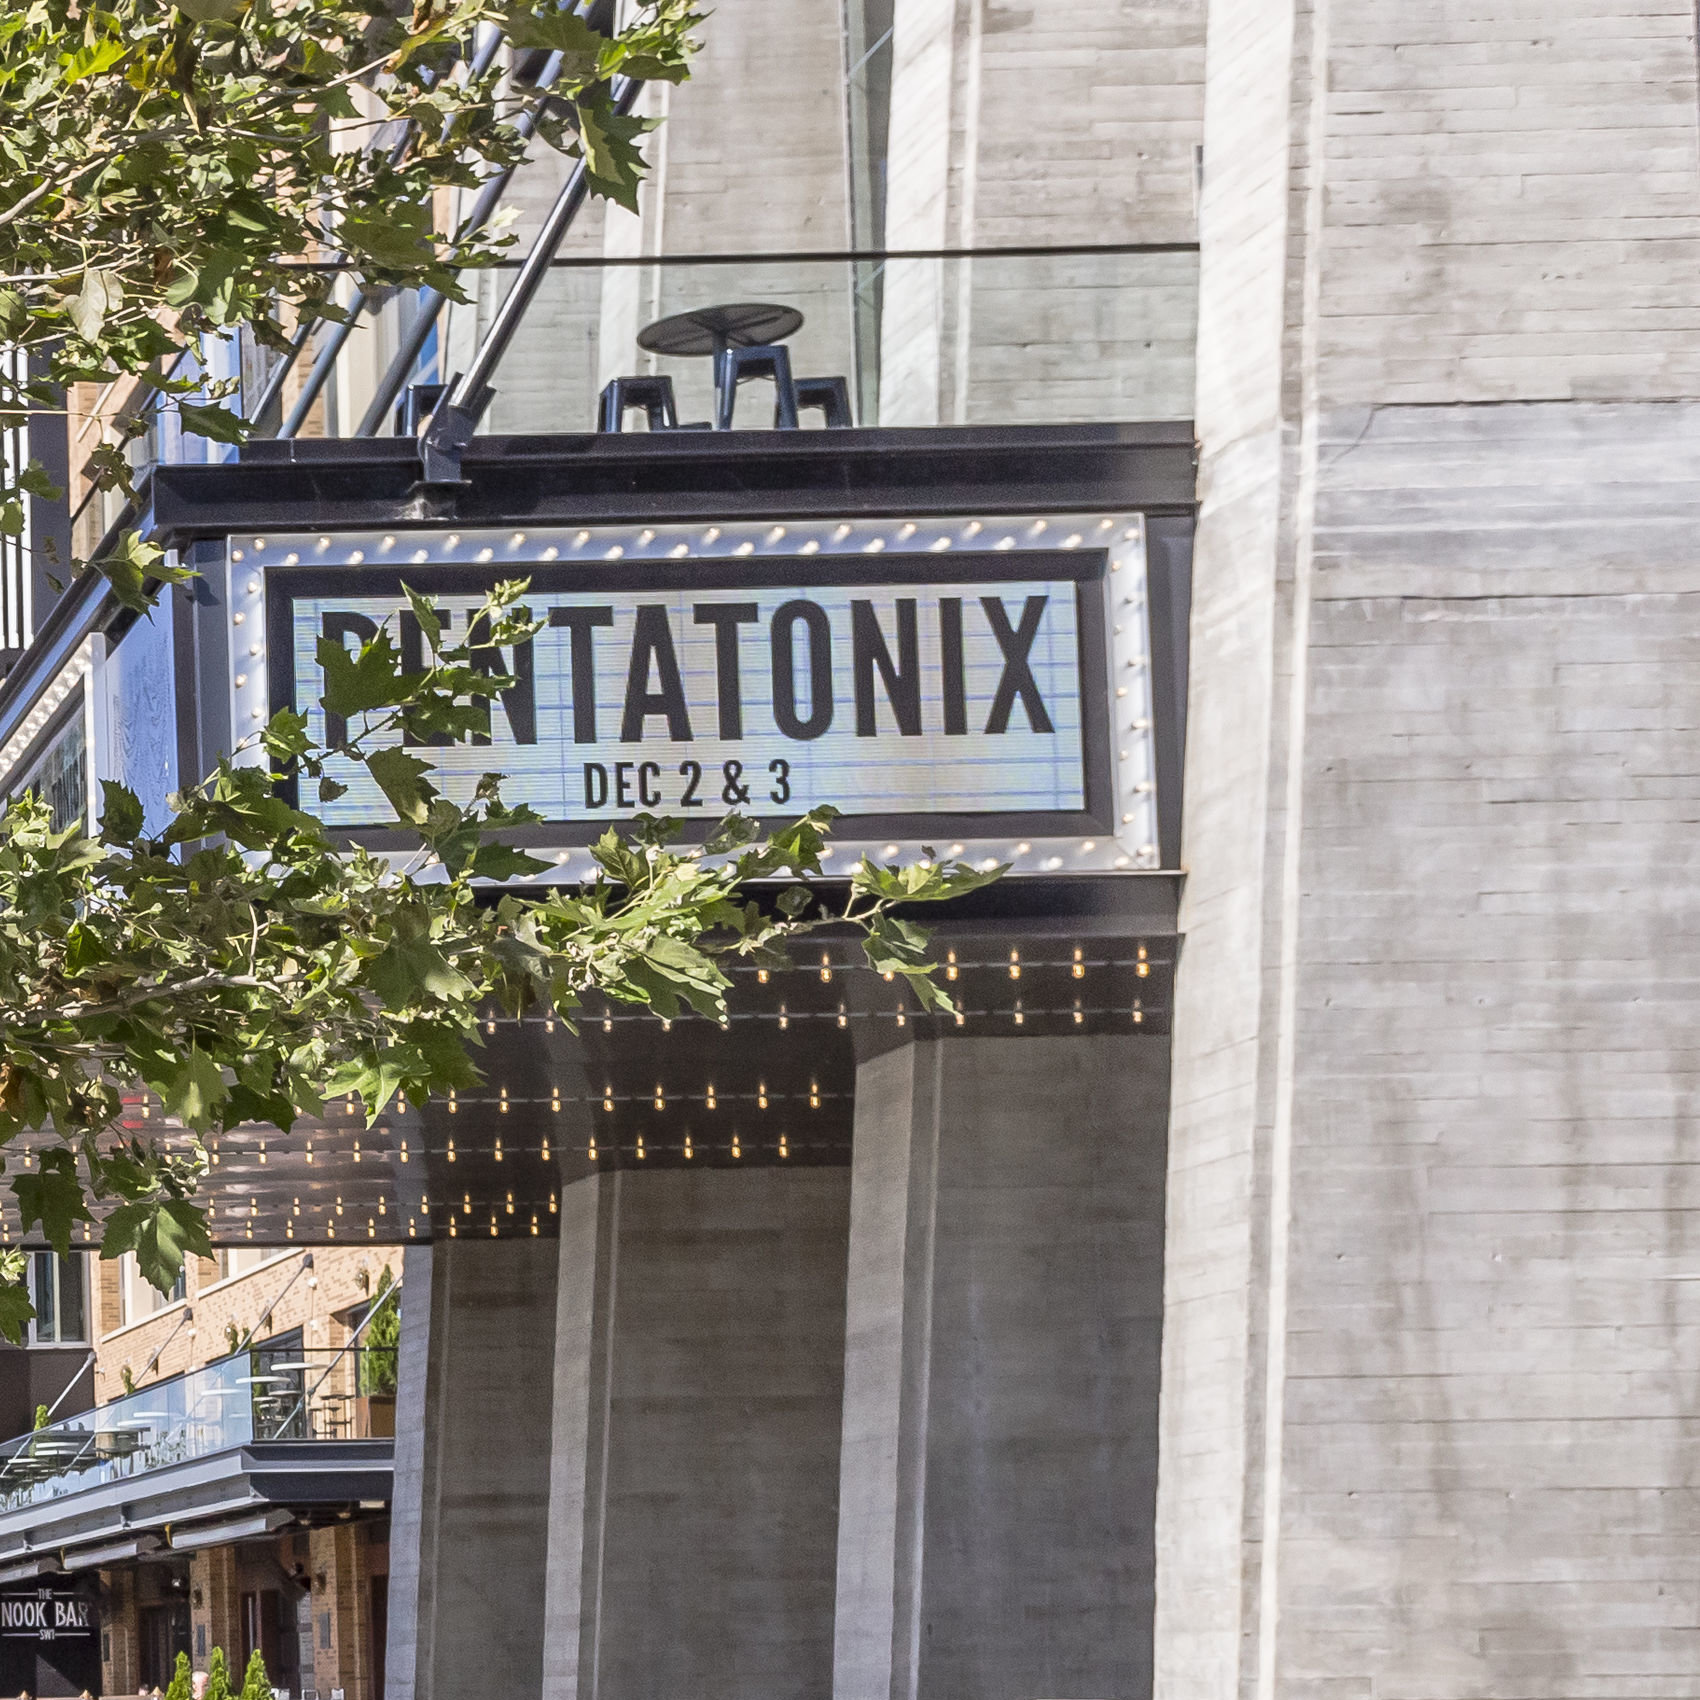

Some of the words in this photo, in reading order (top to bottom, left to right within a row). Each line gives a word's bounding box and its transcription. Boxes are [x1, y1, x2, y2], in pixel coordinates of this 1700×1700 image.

[584, 762, 661, 809] DEC
[680, 760, 702, 807] 2
[723, 760, 750, 804] &
[770, 759, 790, 804] 3
[38, 1588, 52, 1600] THE
[1, 1601, 47, 1627] NOOK
[55, 1601, 89, 1627] BAR
